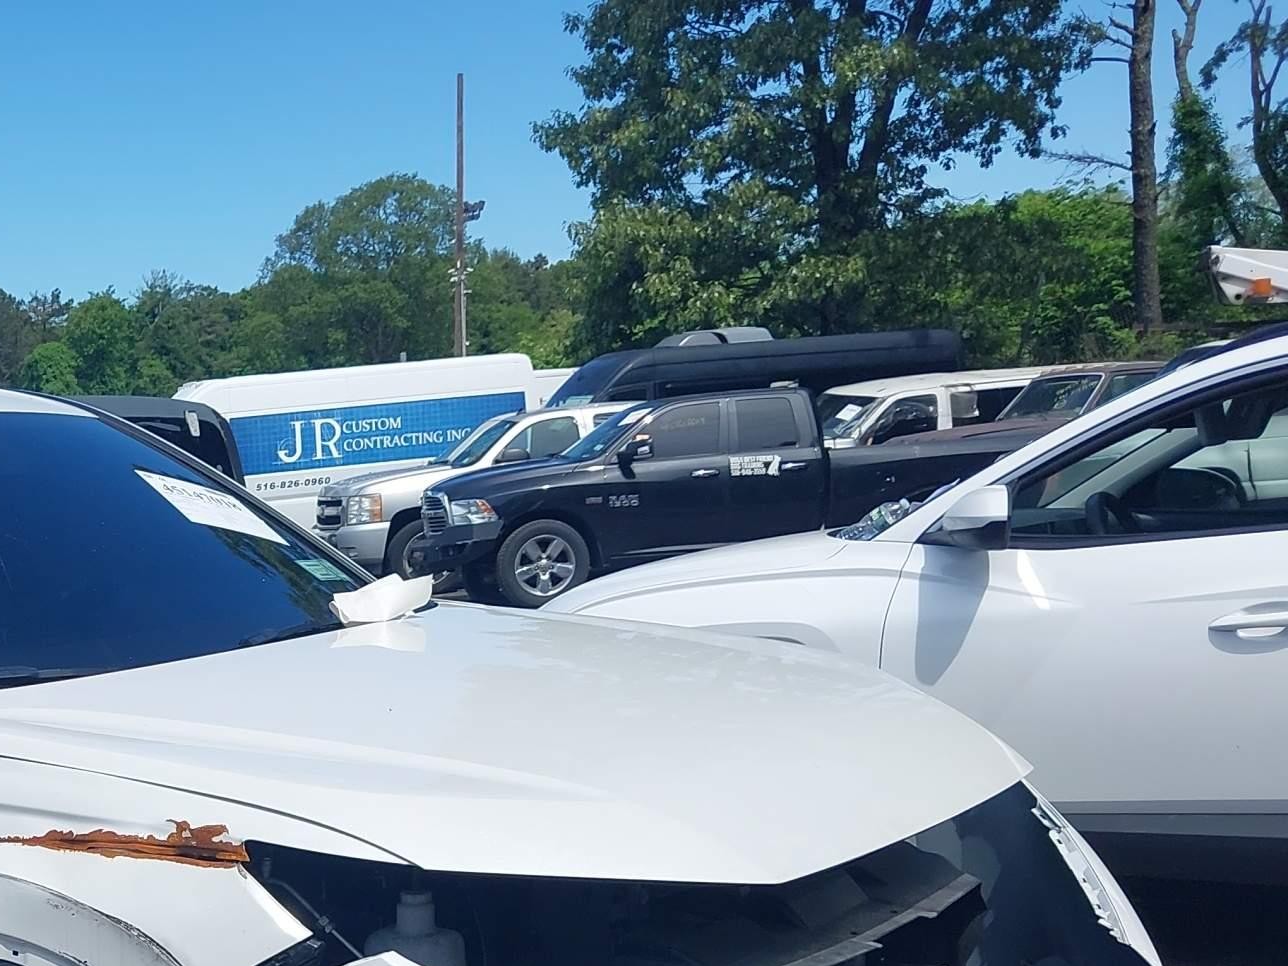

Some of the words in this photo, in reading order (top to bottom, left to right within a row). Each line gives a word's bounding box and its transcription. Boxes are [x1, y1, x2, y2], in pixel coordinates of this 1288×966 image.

[342, 416, 402, 434] CUSTOM
[343, 430, 444, 452] CONTRACTING
[255, 476, 331, 492] 516-826-0960
